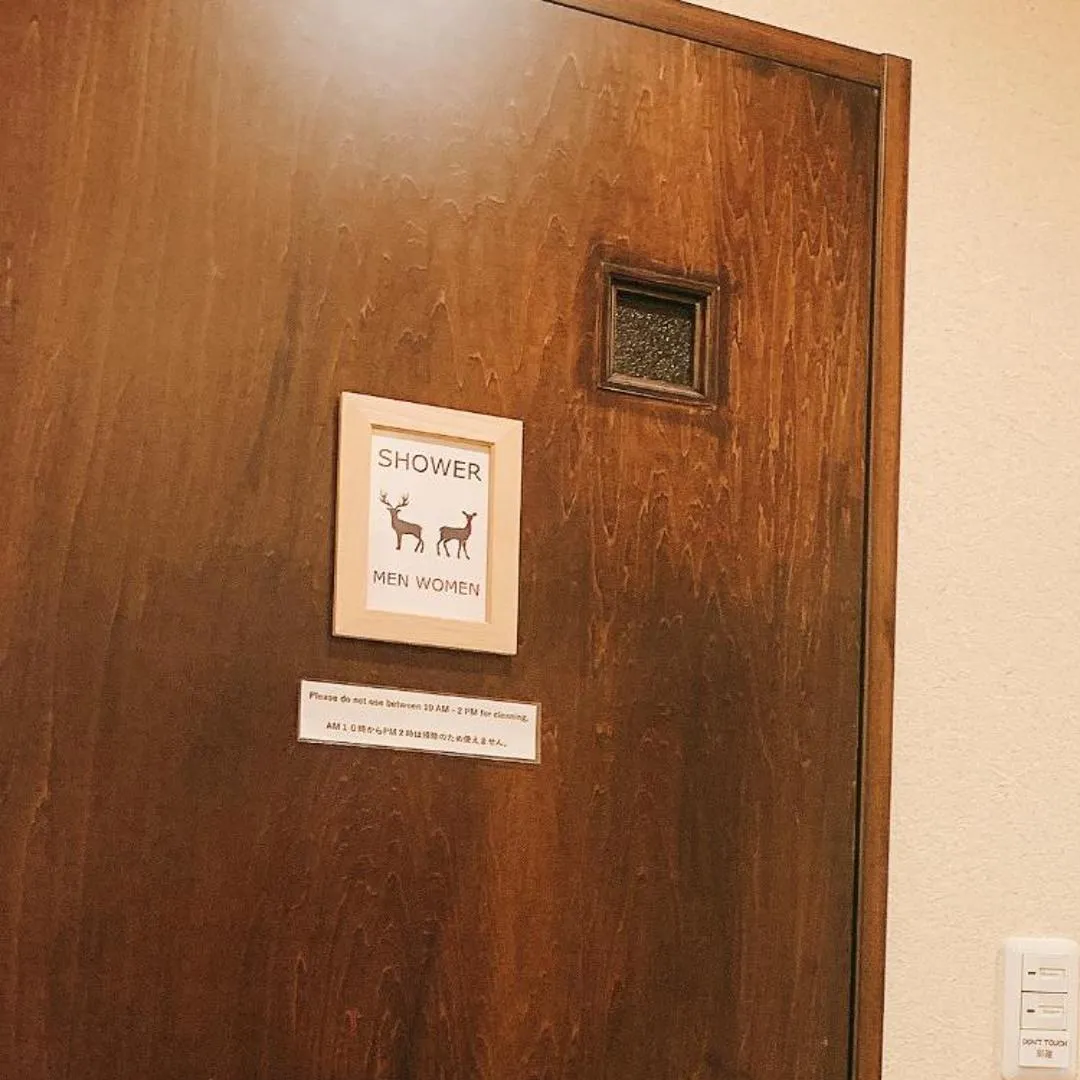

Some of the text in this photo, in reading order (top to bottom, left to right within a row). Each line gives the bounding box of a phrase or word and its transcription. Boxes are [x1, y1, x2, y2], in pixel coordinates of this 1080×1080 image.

[378, 448, 482, 482] SHOWER
[373, 569, 480, 597] MEN WOMEN
[309, 691, 338, 703] Please
[341, 695, 351, 704] do
[352, 697, 367, 705] not
[386, 699, 422, 711] between
[436, 704, 450, 713] AM
[457, 706, 463, 715] 2
[465, 707, 478, 716] PM
[480, 709, 492, 718] for
